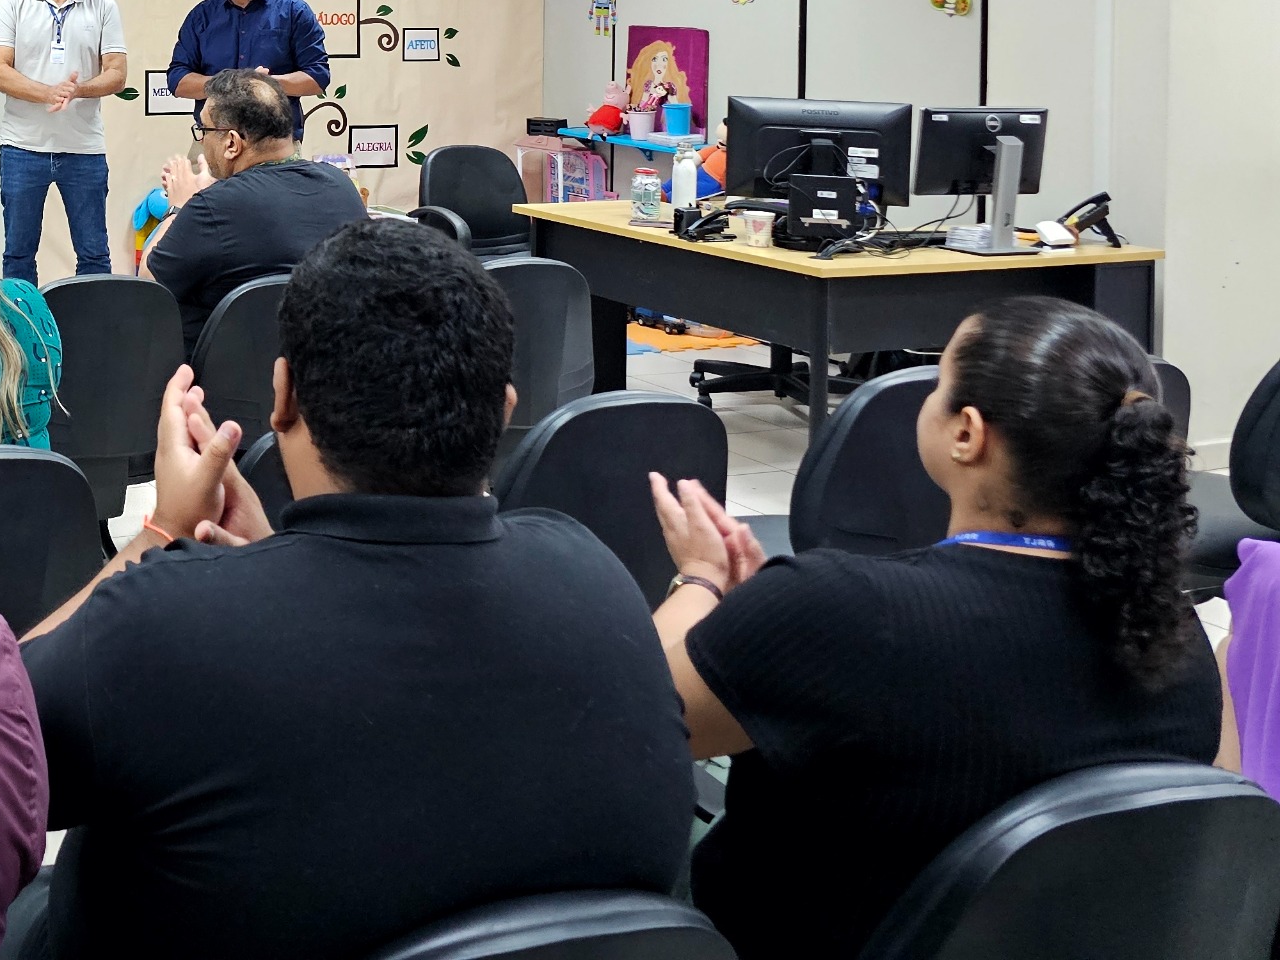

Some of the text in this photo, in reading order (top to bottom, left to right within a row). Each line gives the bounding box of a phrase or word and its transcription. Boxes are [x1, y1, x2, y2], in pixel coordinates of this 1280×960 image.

[316, 11, 356, 25] ÁLOGO
[407, 39, 437, 50] AFETO
[354, 142, 393, 152] ALEGRIA
